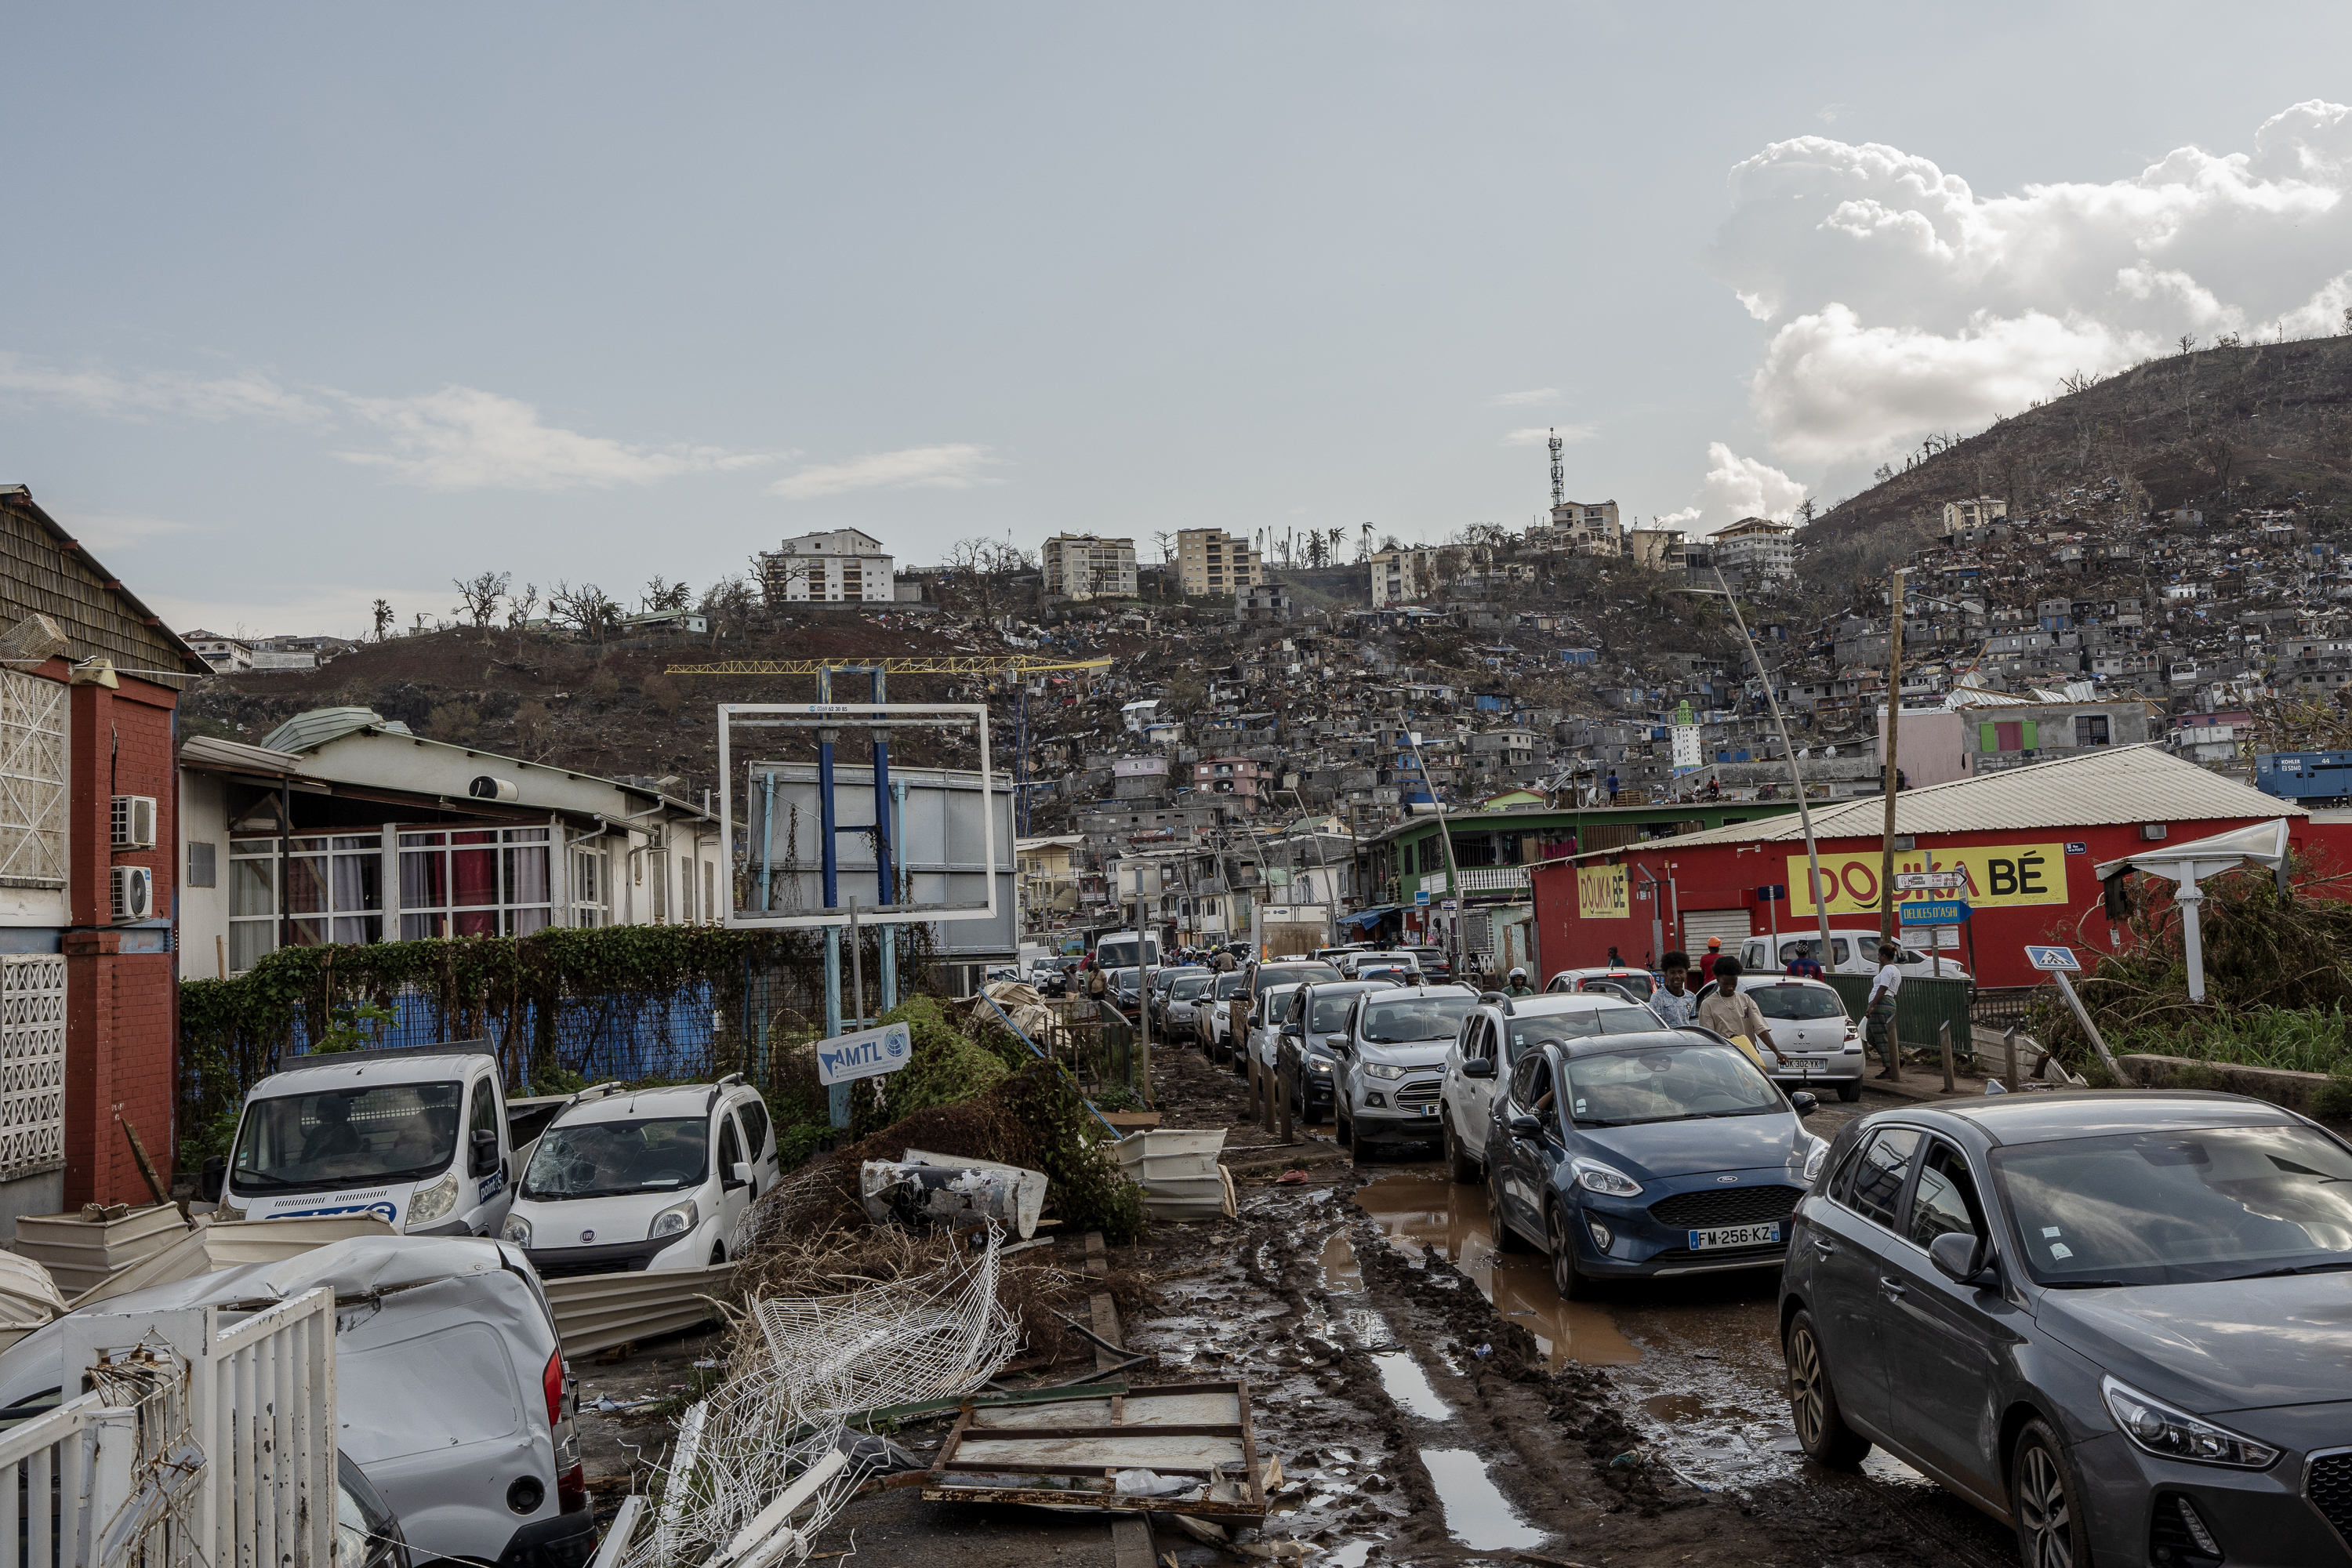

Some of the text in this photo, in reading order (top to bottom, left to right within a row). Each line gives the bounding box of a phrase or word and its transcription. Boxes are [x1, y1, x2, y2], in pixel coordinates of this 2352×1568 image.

[1988, 850, 2048, 896] BÉ
[1581, 869, 1625, 909] DOUKA BÉ
[1904, 906, 1958, 920] DELICES D'ASHI
[835, 1042, 882, 1066] AMTL
[481, 1173, 502, 1202] point S
[1698, 1226, 1770, 1247] FM-256-KZ
